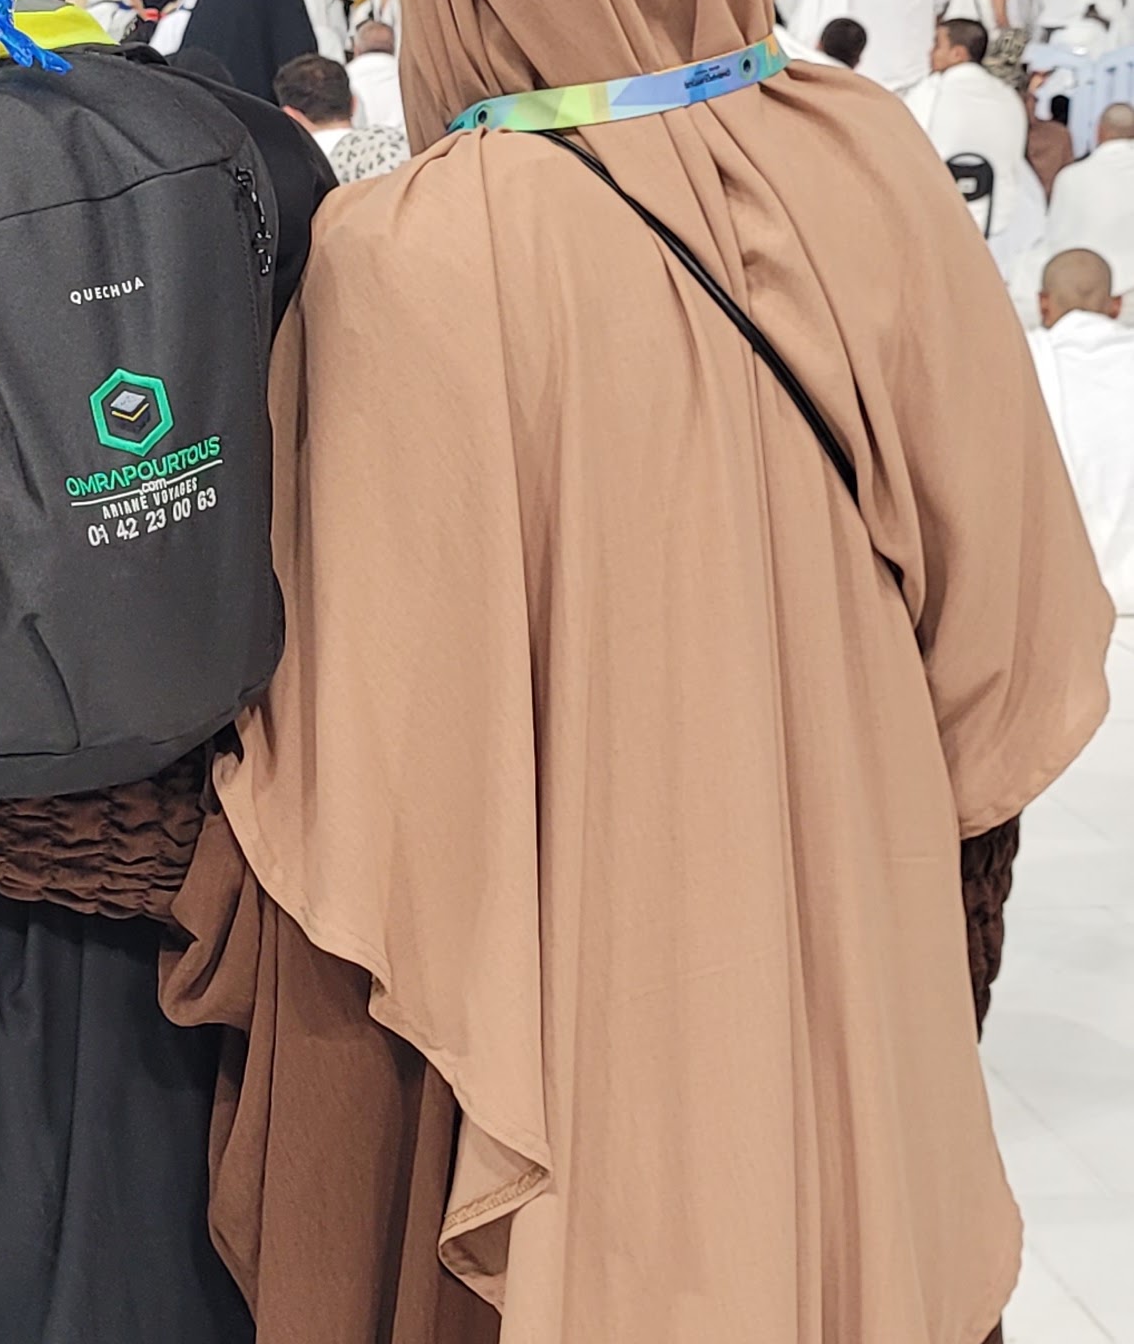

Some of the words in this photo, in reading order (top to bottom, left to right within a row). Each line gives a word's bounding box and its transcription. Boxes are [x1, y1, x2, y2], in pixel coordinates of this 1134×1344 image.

[69, 276, 144, 304] QUECHUA
[66, 436, 221, 496] OMRAPOURTOUS
[153, 477, 198, 506] VOYAGES
[88, 524, 110, 546] 01
[116, 517, 139, 540] 42
[145, 508, 166, 533] 23
[173, 498, 191, 521] 00
[197, 487, 216, 511] 63
